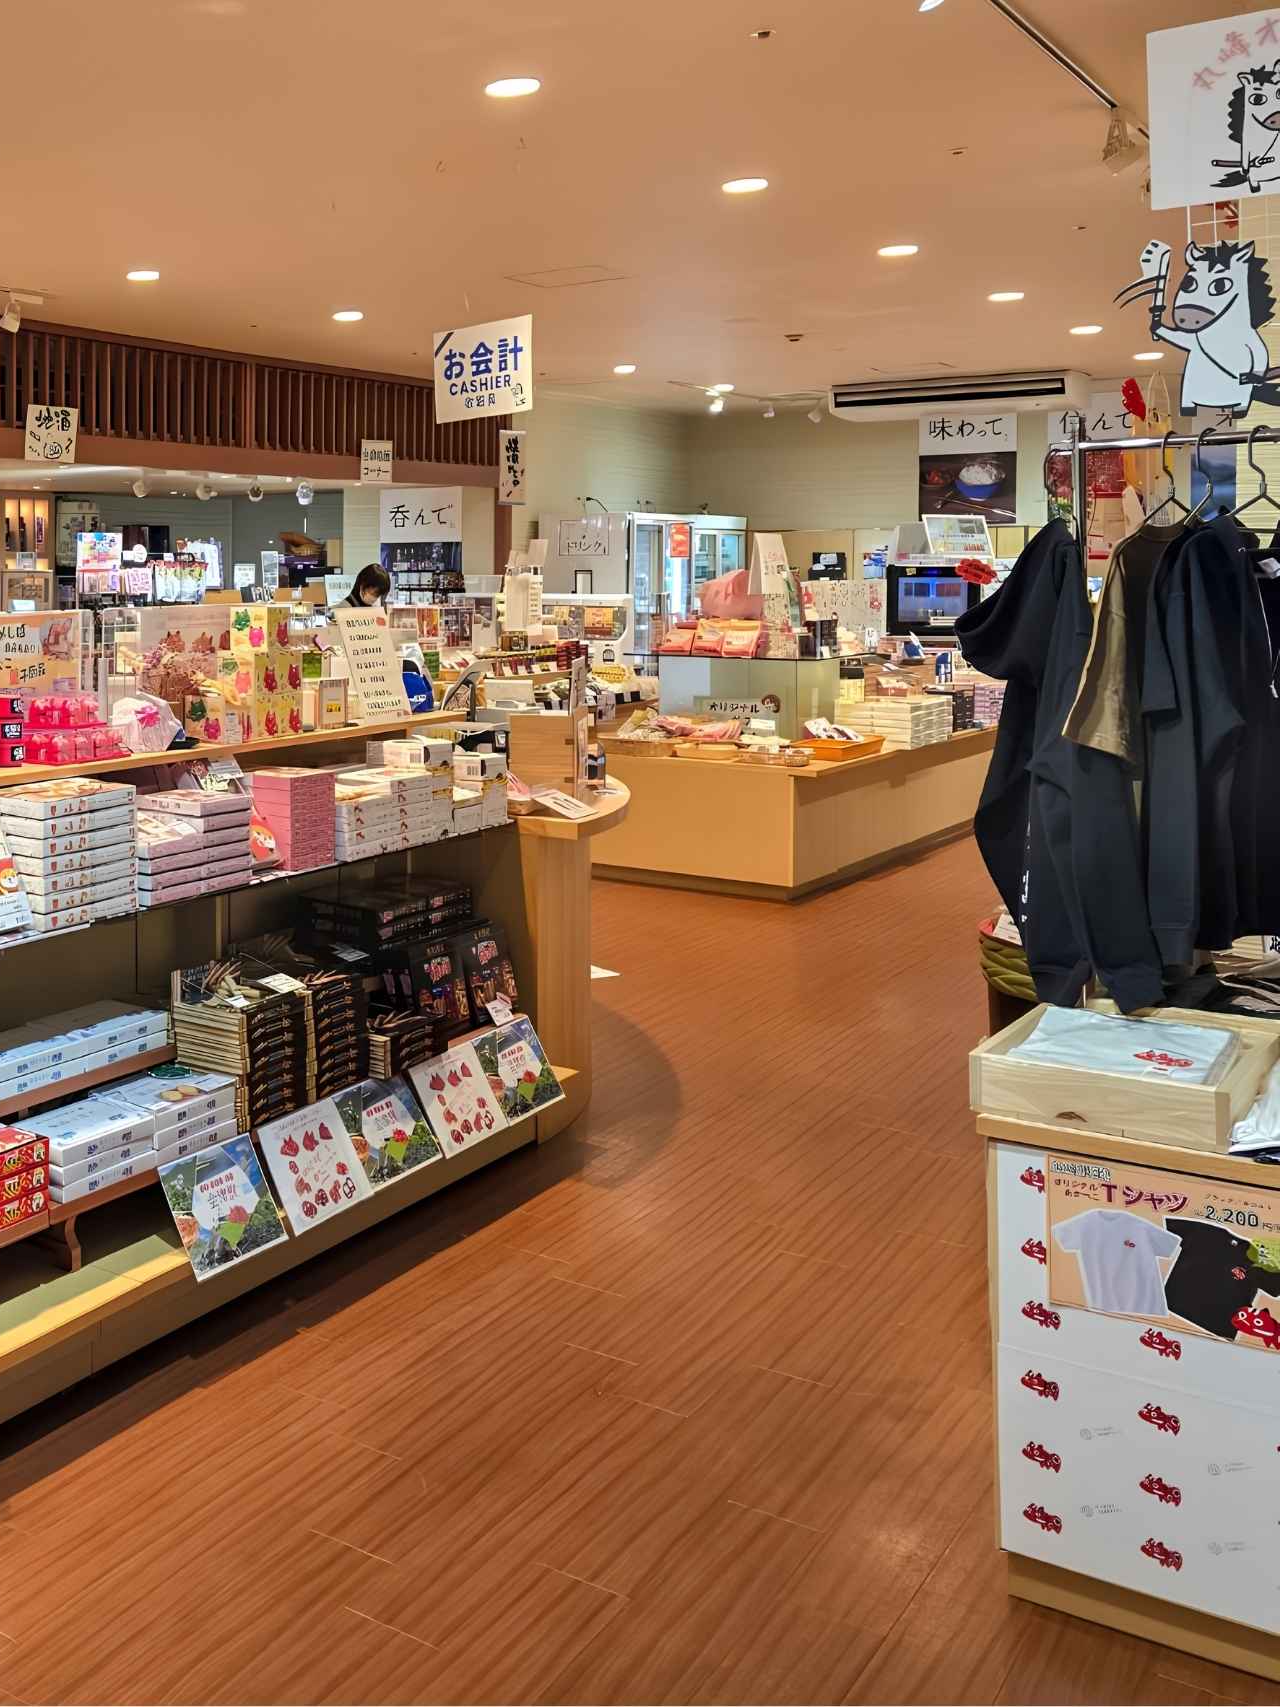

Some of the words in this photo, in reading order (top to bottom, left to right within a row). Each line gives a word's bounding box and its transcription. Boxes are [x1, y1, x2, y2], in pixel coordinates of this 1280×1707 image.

[444, 336, 523, 381] お会計
[449, 375, 511, 396] CASHIER
[929, 417, 1003, 440] 味わって
[389, 503, 453, 528] 呑んで
[1102, 1183, 1188, 1213] Tシャツ
[1205, 1205, 1259, 1227] 2,200
